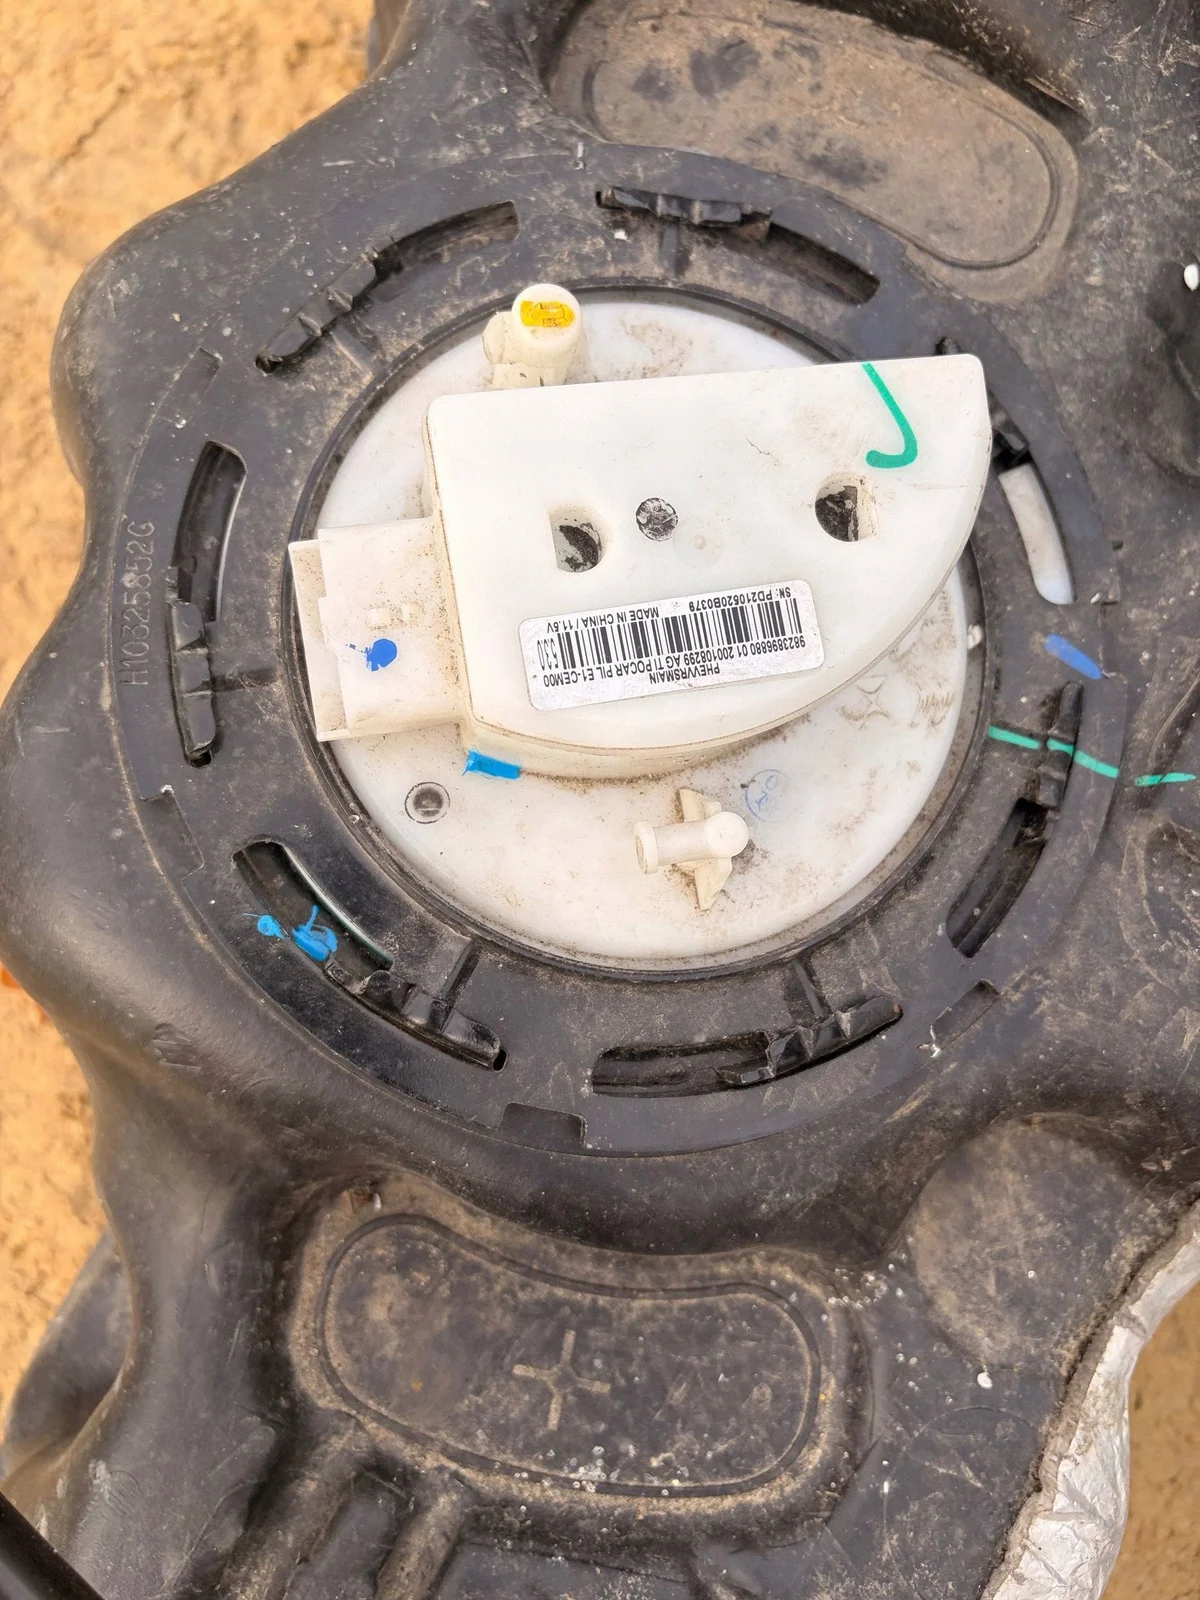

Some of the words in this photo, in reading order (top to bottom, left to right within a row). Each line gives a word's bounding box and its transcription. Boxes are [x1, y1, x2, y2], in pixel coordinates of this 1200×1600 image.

[775, 586, 792, 599] SN:
[688, 589, 773, 612] PD210520B0379
[581, 613, 614, 625] CHINA
[616, 611, 627, 623] IN
[629, 606, 660, 620] MADE
[737, 644, 749, 658] 01
[750, 635, 806, 656] 9823896880
[666, 654, 681, 669] AG
[684, 645, 735, 666] 200108299
[596, 666, 613, 679] PIL
[615, 658, 651, 676] POCAR
